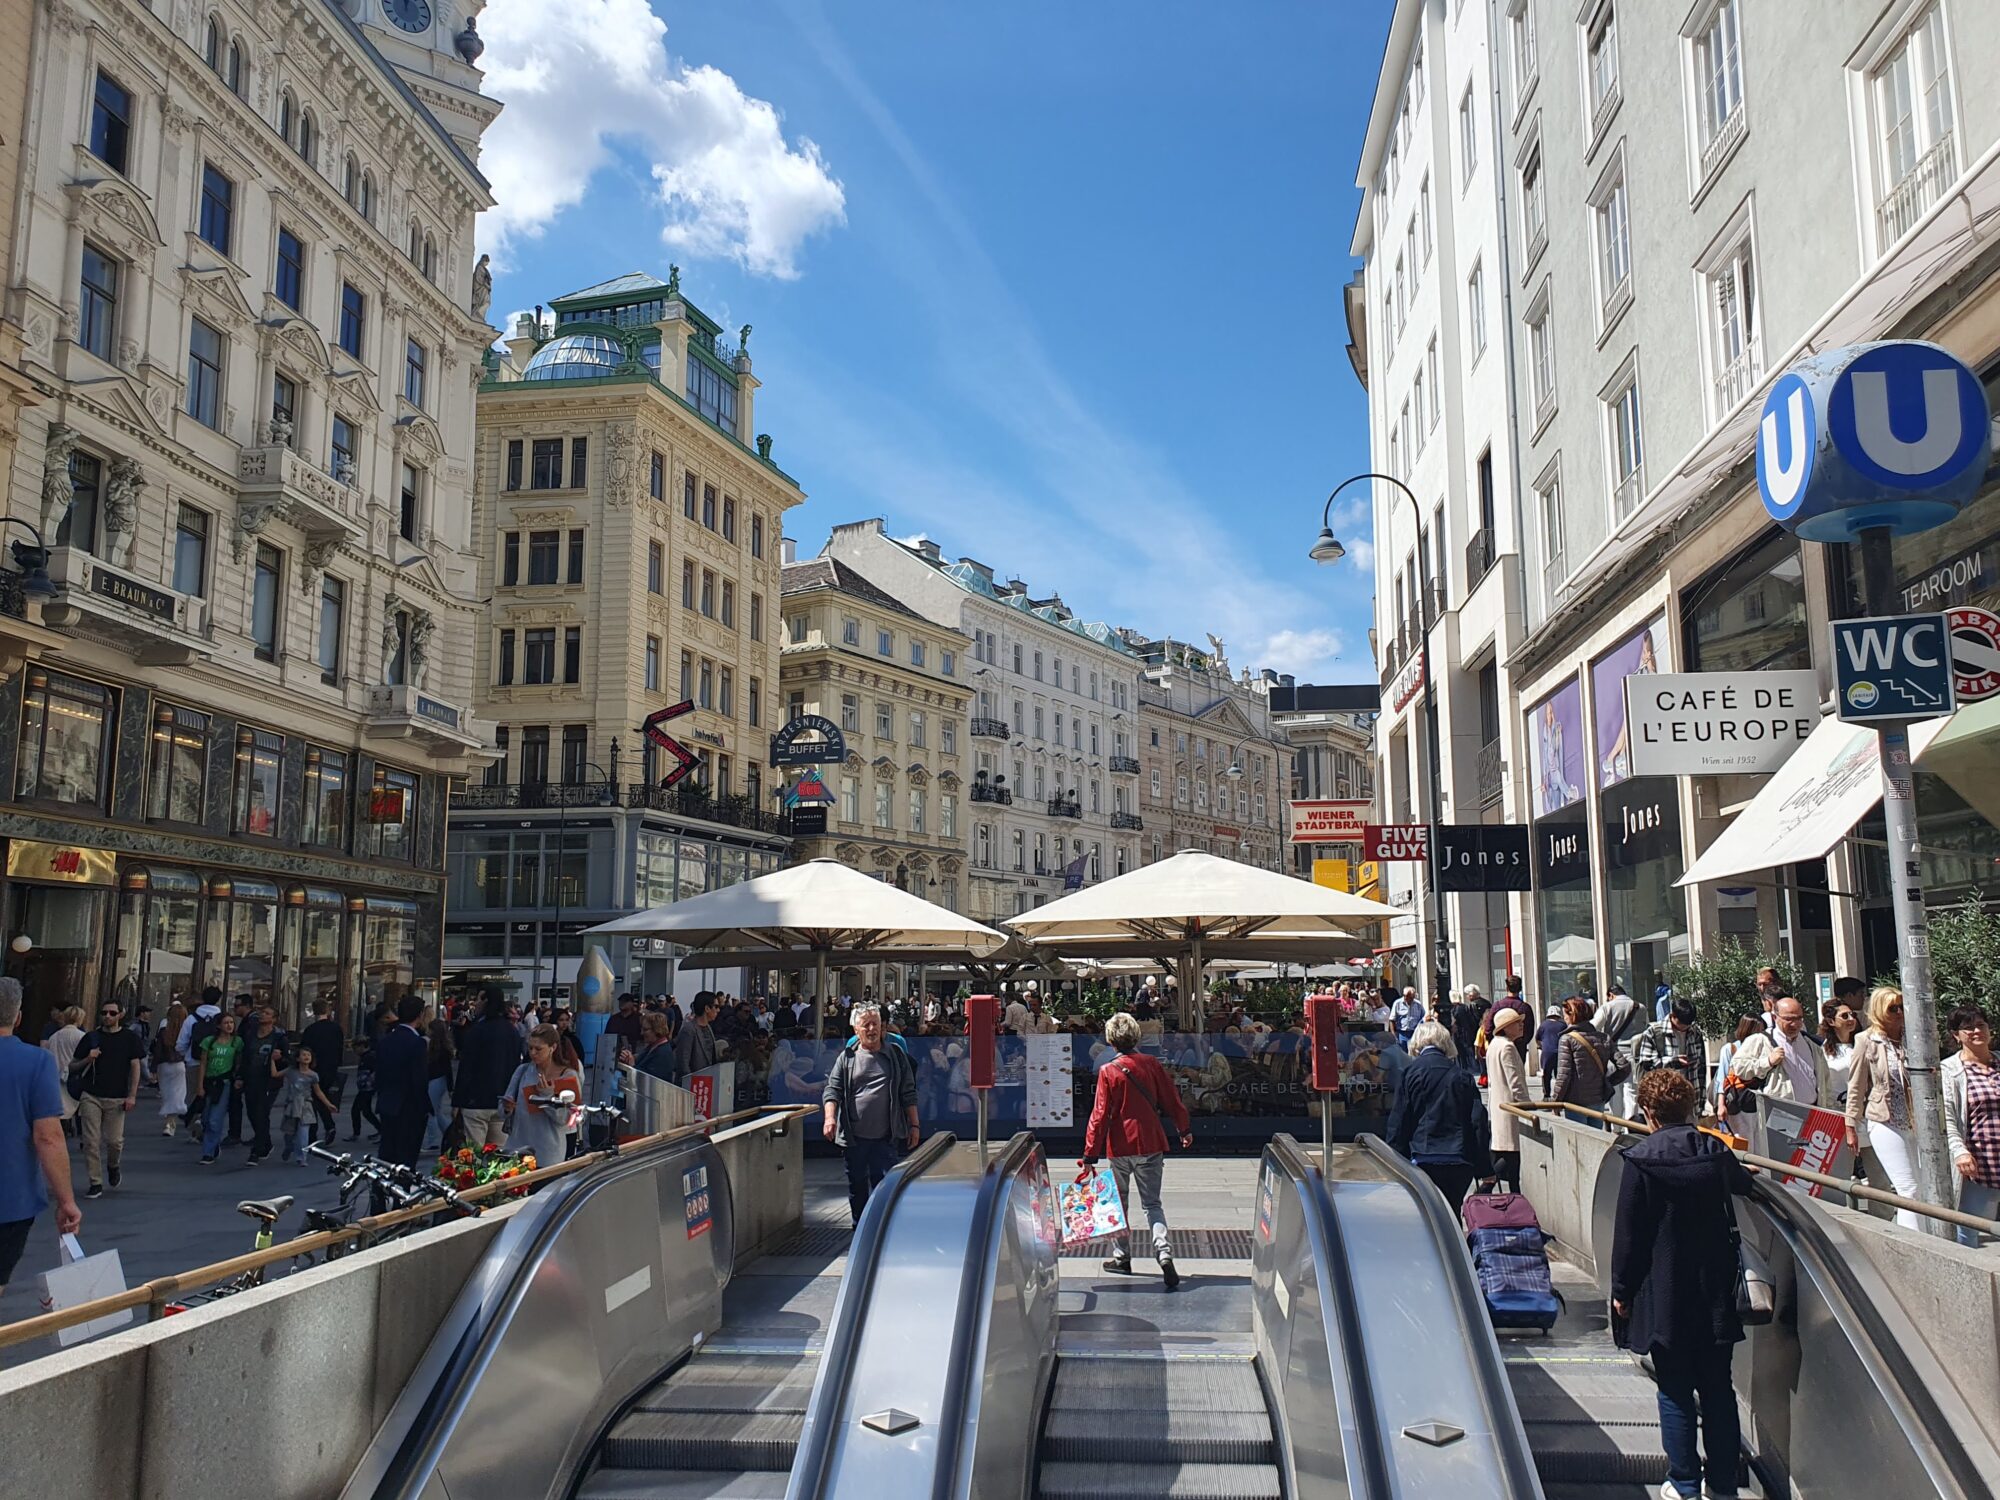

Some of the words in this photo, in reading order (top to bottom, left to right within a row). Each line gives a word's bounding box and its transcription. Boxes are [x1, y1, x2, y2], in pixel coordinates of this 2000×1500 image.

[1851, 369, 1962, 475] U
[1761, 386, 1807, 507] U
[113, 580, 147, 605] BRAUN
[1901, 551, 1982, 612] TEAROOM
[1841, 623, 1939, 672] WC
[1656, 685, 1737, 711] CAFÉ
[1754, 688, 1794, 708] DE
[1643, 719, 1810, 743] L'EUROPE
[648, 729, 692, 764] FLEDERMAUS
[788, 744, 827, 755] BUFFET
[1702, 756, 1720, 765] Wien
[1722, 756, 1734, 765] seit
[1736, 755, 1757, 765] 1952
[1295, 820, 1368, 831] STADTBRÄU
[1307, 811, 1355, 820] WIENER
[1622, 804, 1660, 844] Jones
[1382, 828, 1426, 842] FIVE
[1441, 846, 1520, 871] Jones
[1550, 834, 1577, 867] Jones
[1226, 1081, 1269, 1094] CAFÉ
[1277, 1082, 1297, 1094] DE
